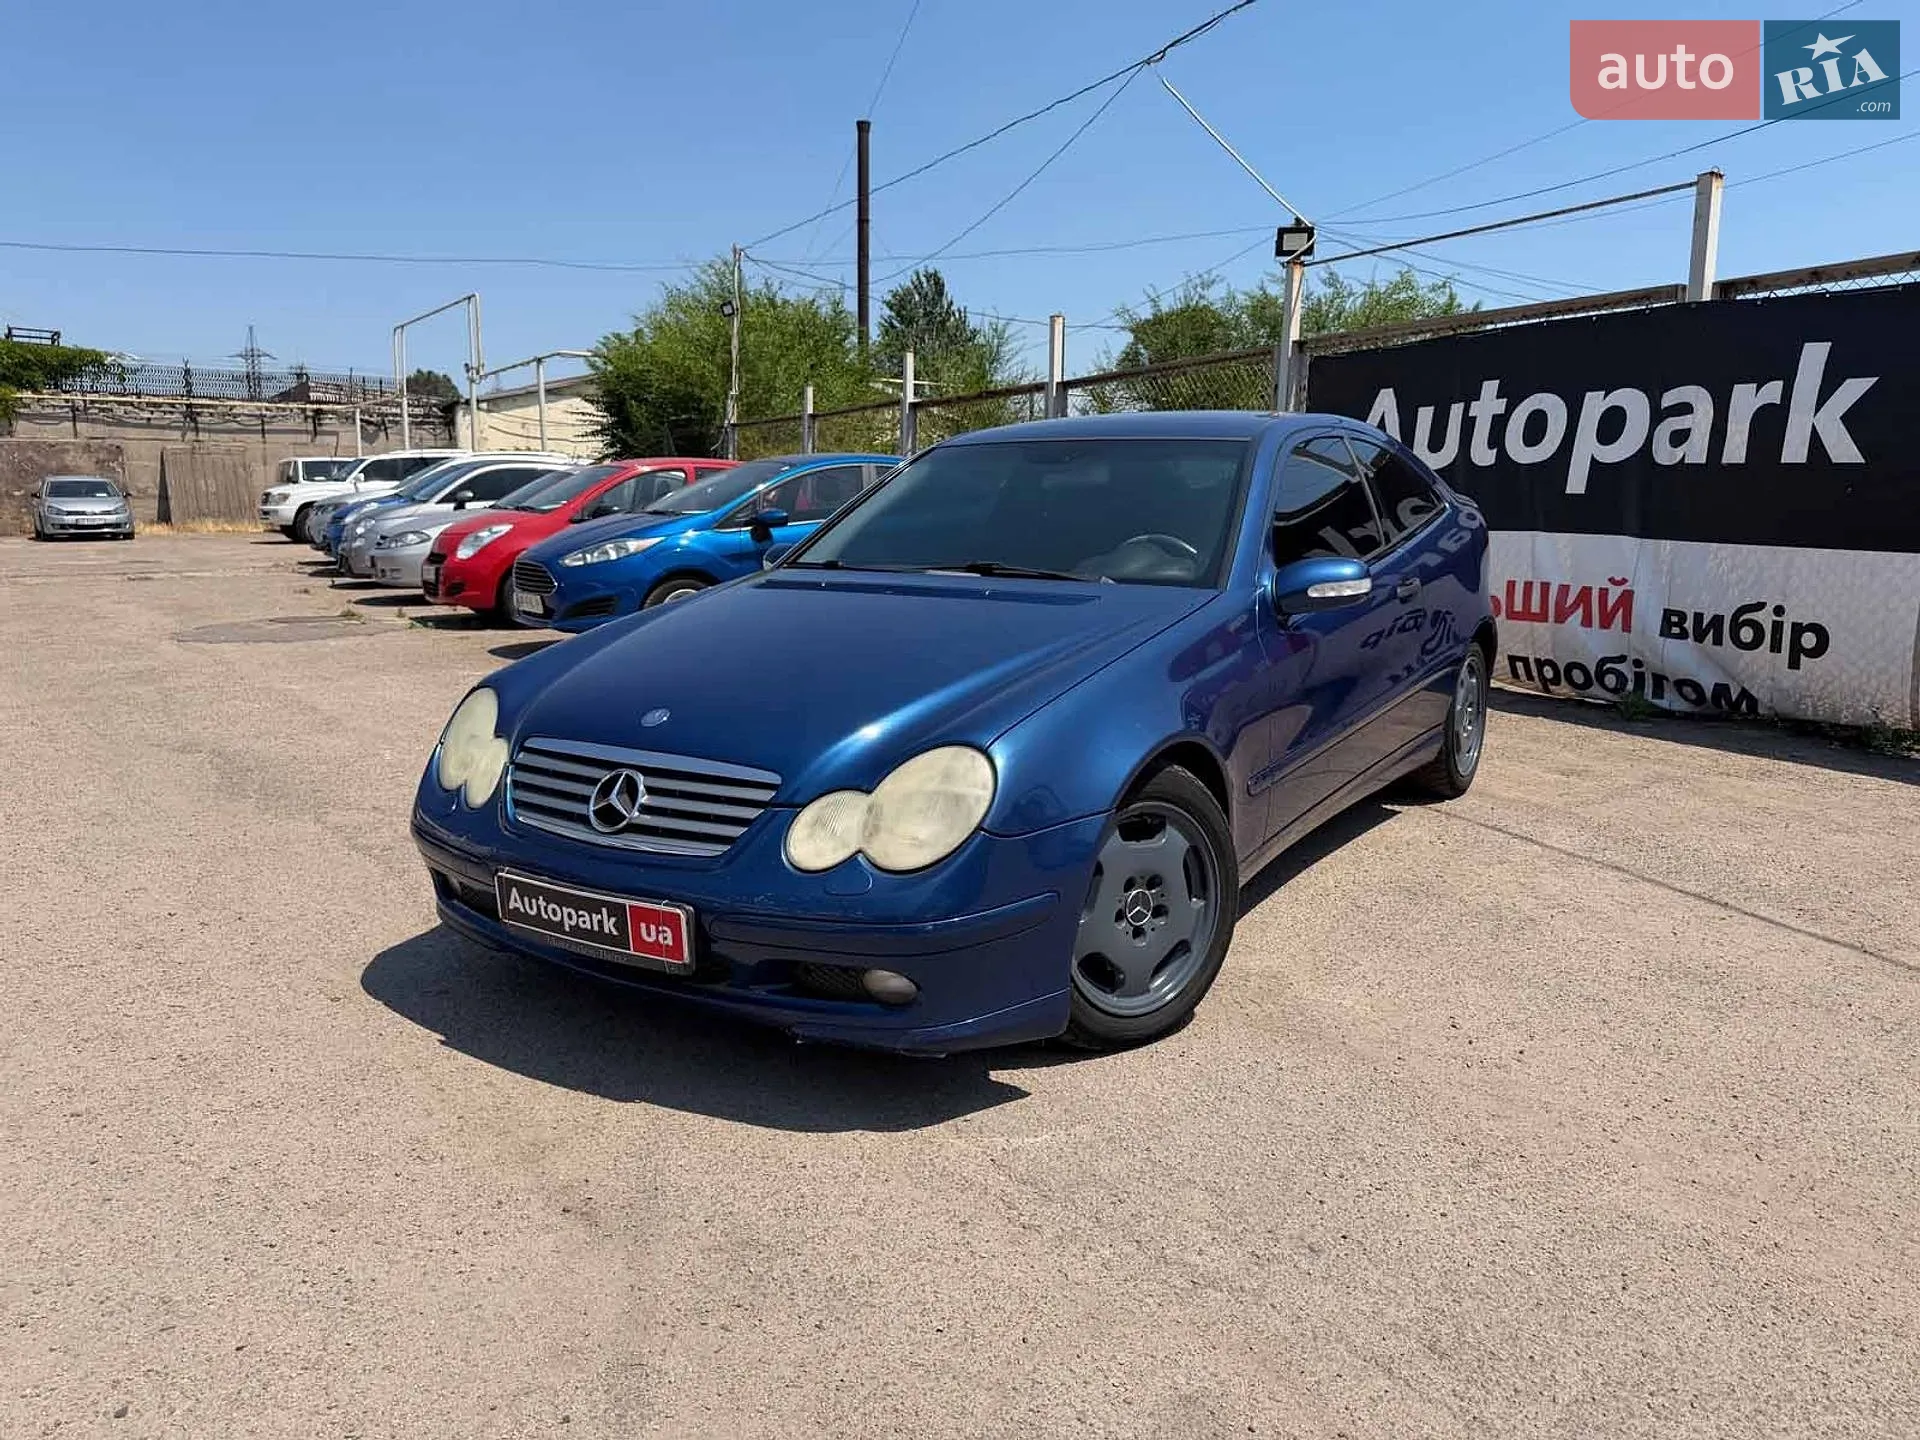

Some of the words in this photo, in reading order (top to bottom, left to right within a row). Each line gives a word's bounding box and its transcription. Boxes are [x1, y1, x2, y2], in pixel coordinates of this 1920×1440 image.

[1365, 341, 1880, 494] Autopark
[1658, 601, 1830, 670] вибір
[1507, 654, 1759, 715] пробігом
[508, 886, 619, 936] Autopark
[639, 921, 673, 946] ua
